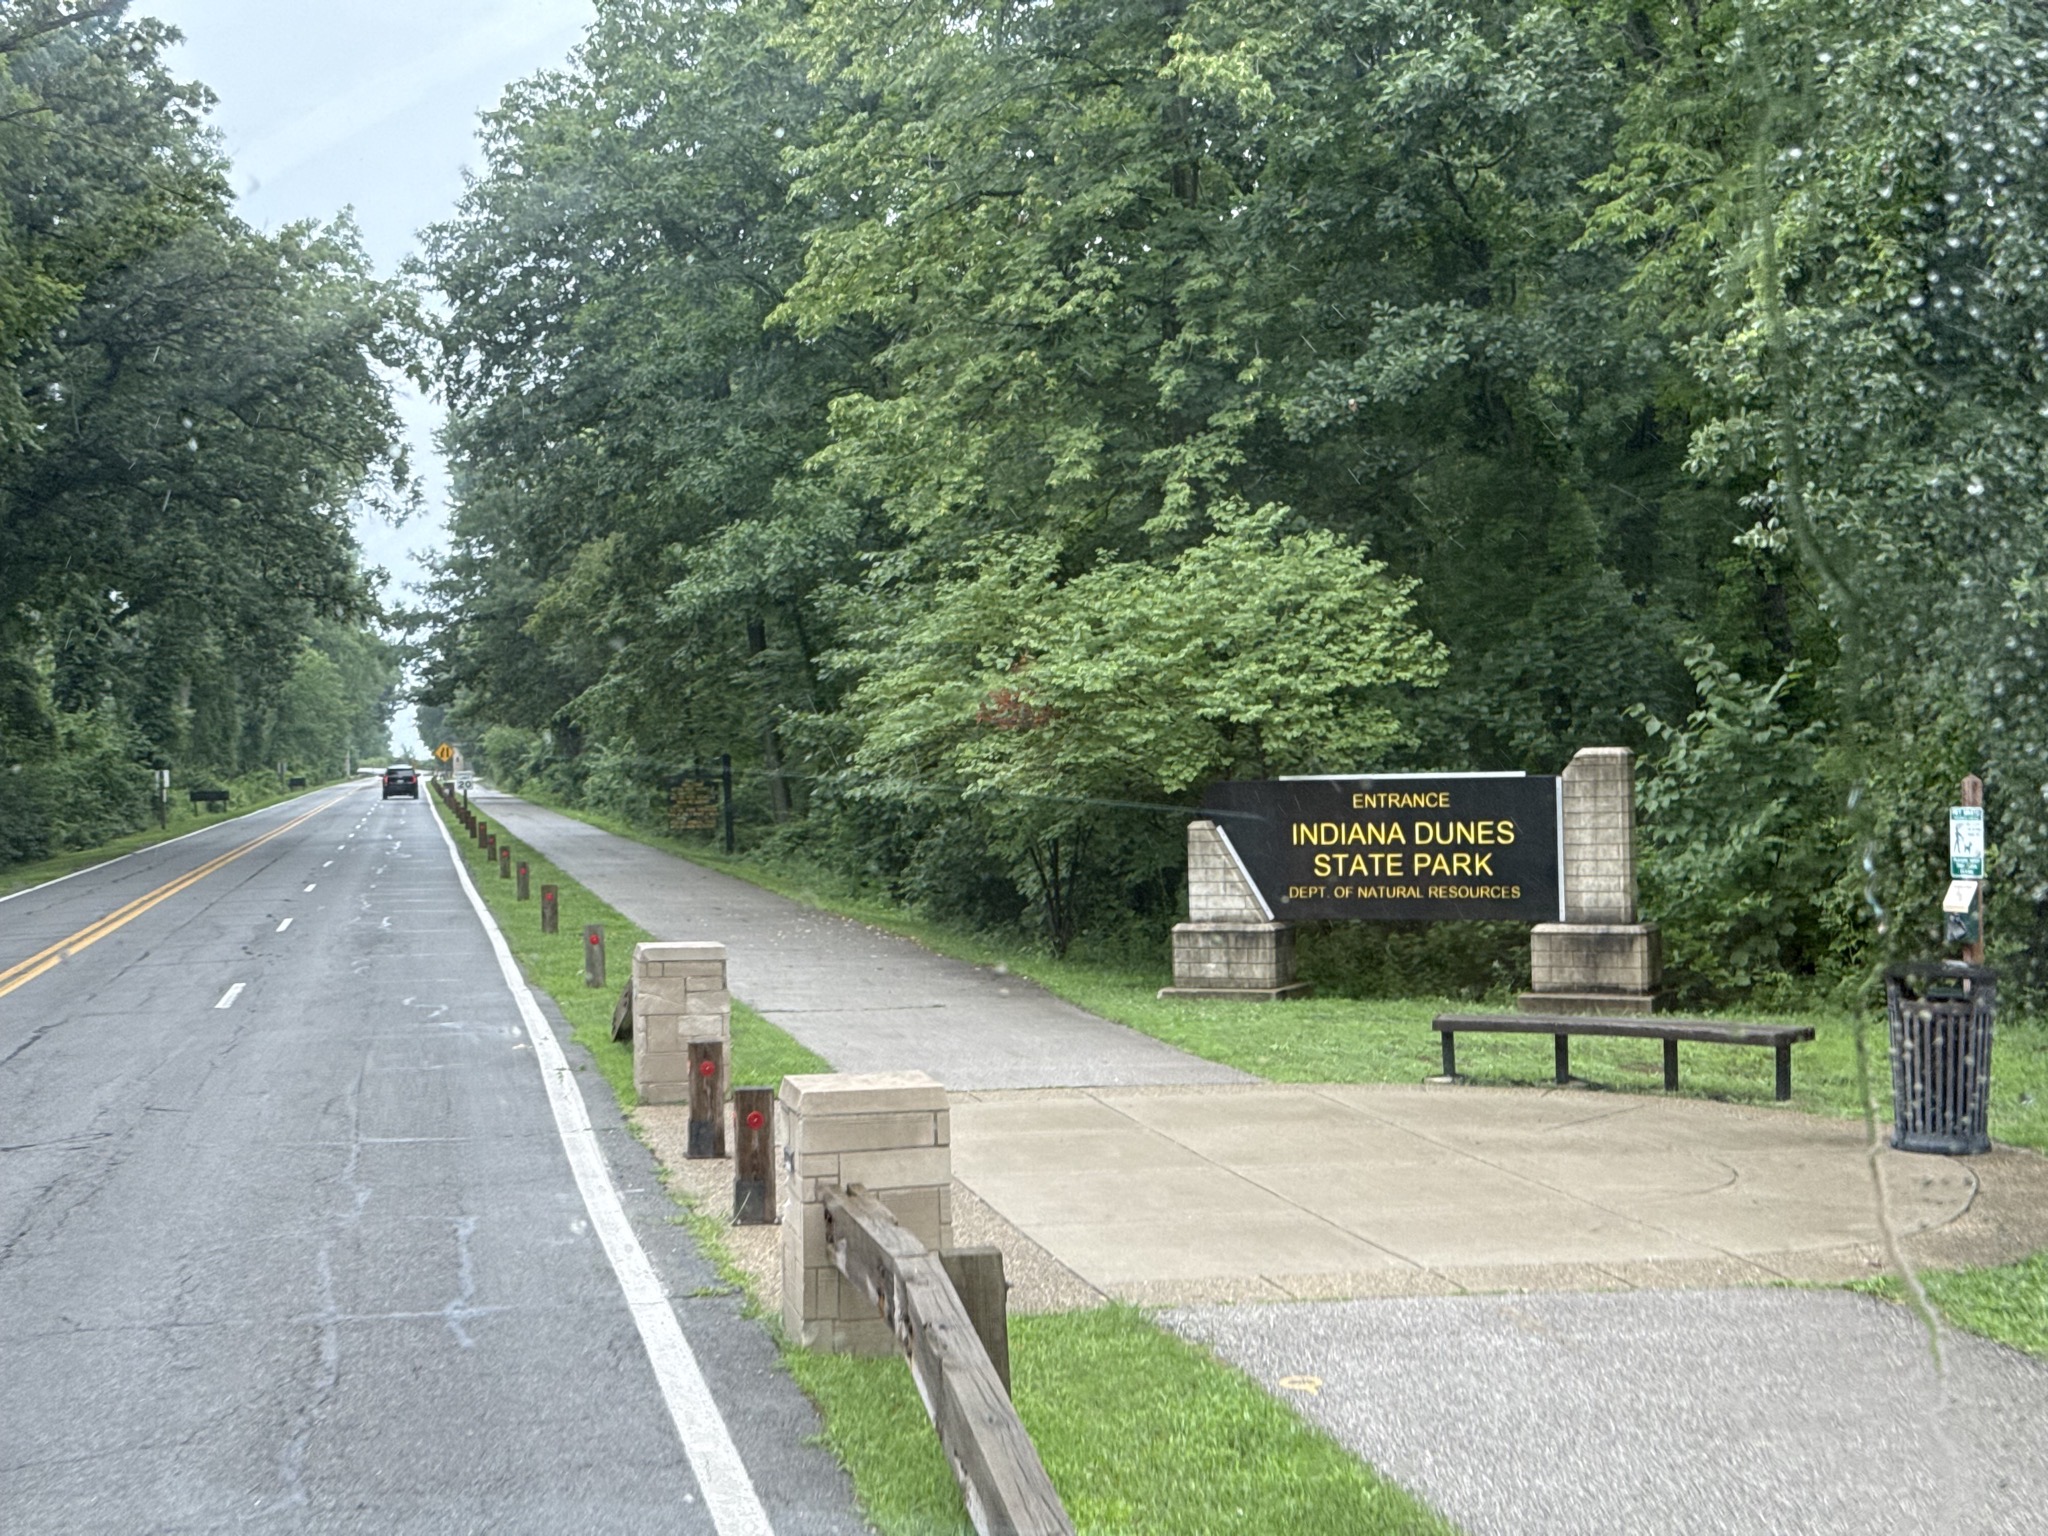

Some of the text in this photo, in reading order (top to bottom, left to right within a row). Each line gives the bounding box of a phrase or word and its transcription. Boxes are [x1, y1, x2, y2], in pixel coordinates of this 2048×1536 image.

[1352, 792, 1450, 809] ENTRANCE
[1292, 820, 1516, 846] INDIANA DUNES
[1313, 852, 1493, 877] STATE PARK
[1288, 884, 1521, 899] DEPT. OF NATURAL RESOURCES
